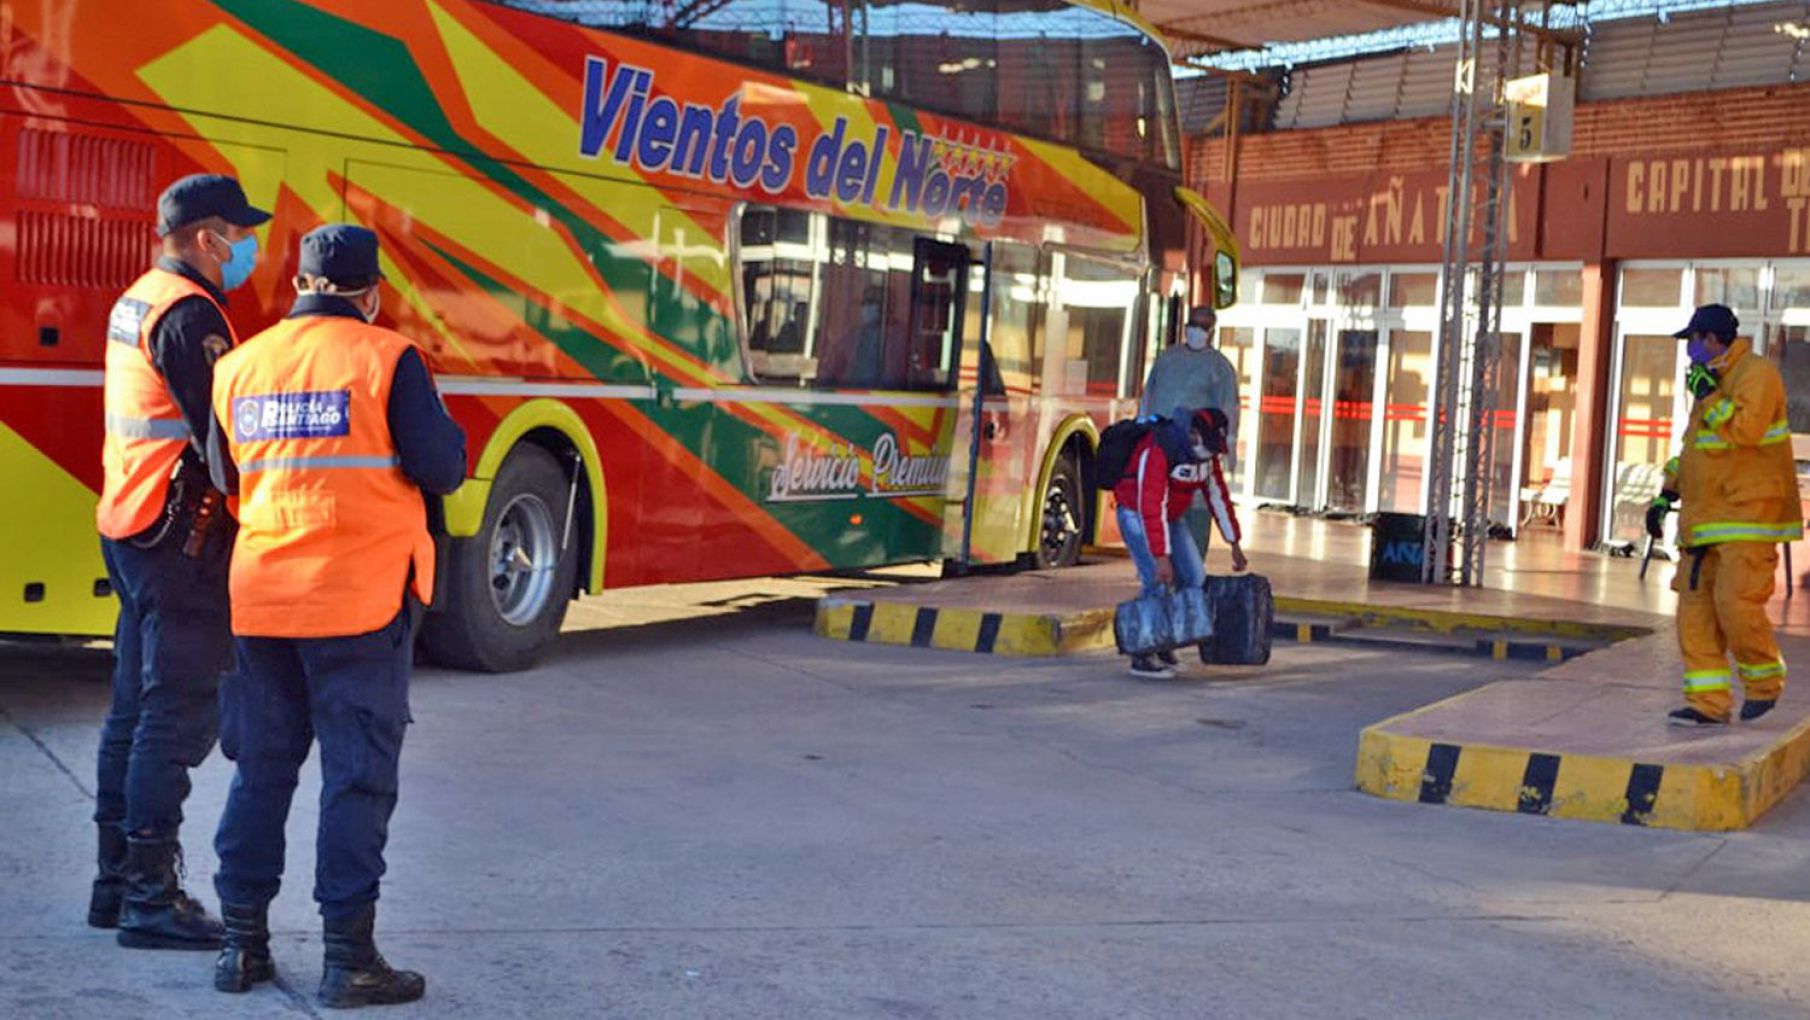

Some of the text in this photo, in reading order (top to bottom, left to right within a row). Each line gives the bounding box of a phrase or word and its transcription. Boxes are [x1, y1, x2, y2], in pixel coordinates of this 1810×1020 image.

[579, 55, 1008, 229] Vientos del Norte
[1519, 116, 1531, 151] 5
[1626, 156, 1768, 214] CAPITAL
[1249, 176, 1518, 262] CIUDAD DE AÑATA
[770, 432, 860, 498] Servicio
